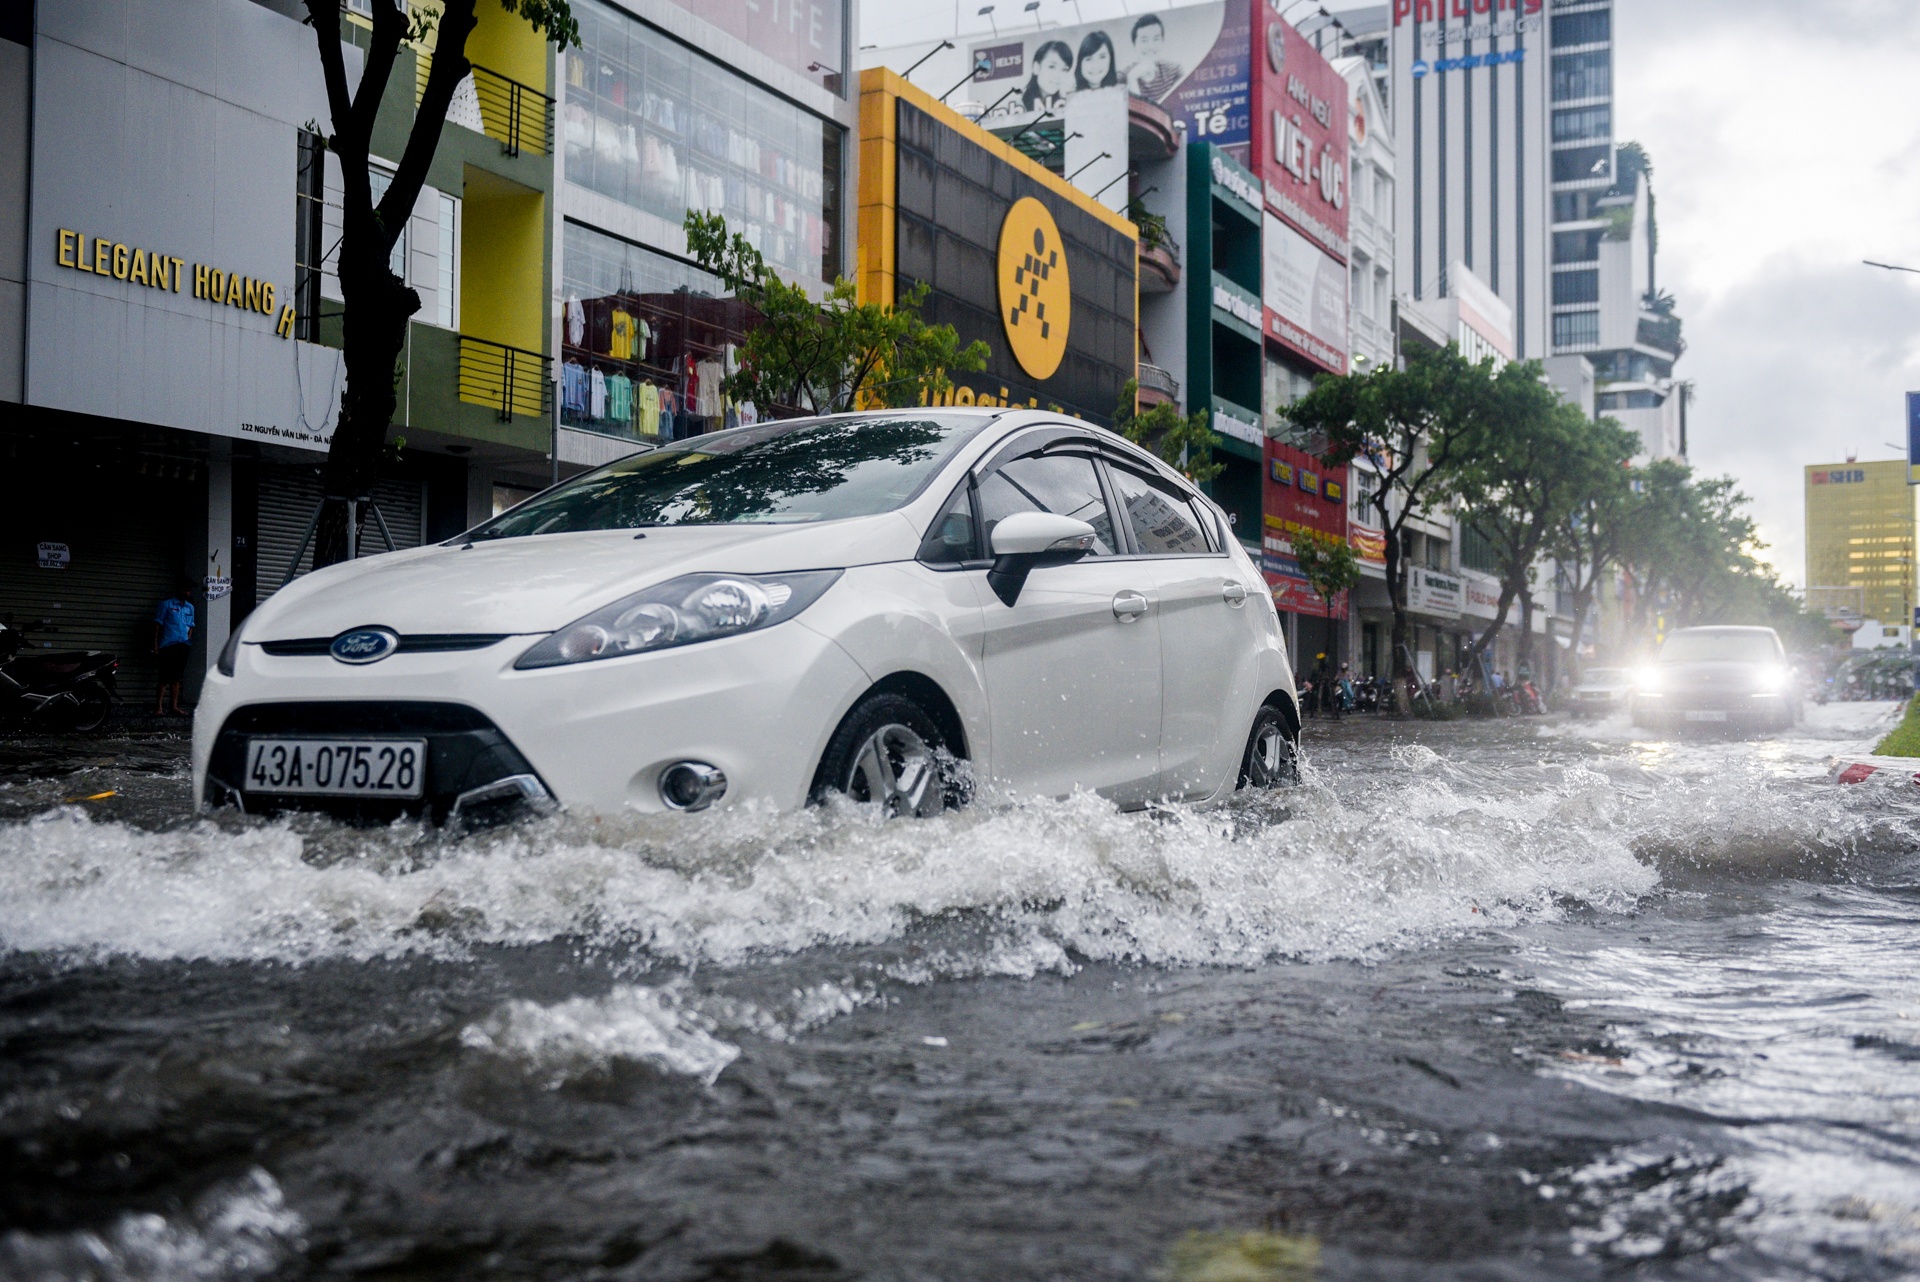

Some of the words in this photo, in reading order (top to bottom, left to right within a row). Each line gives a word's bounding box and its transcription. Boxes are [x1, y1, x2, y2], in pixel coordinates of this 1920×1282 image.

[995, 54, 1022, 68] IELTS
[1194, 64, 1238, 82] IELTS
[1206, 82, 1248, 96] ENGLISH
[1194, 102, 1232, 136] Tế
[58, 228, 185, 293] ELEGANT
[194, 263, 276, 315] HOANG
[241, 423, 253, 432] 122
[295, 432, 309, 442] LINH
[236, 536, 246, 545] 74
[47, 552, 62, 560] SHOP
[341, 635, 380, 653] Ford
